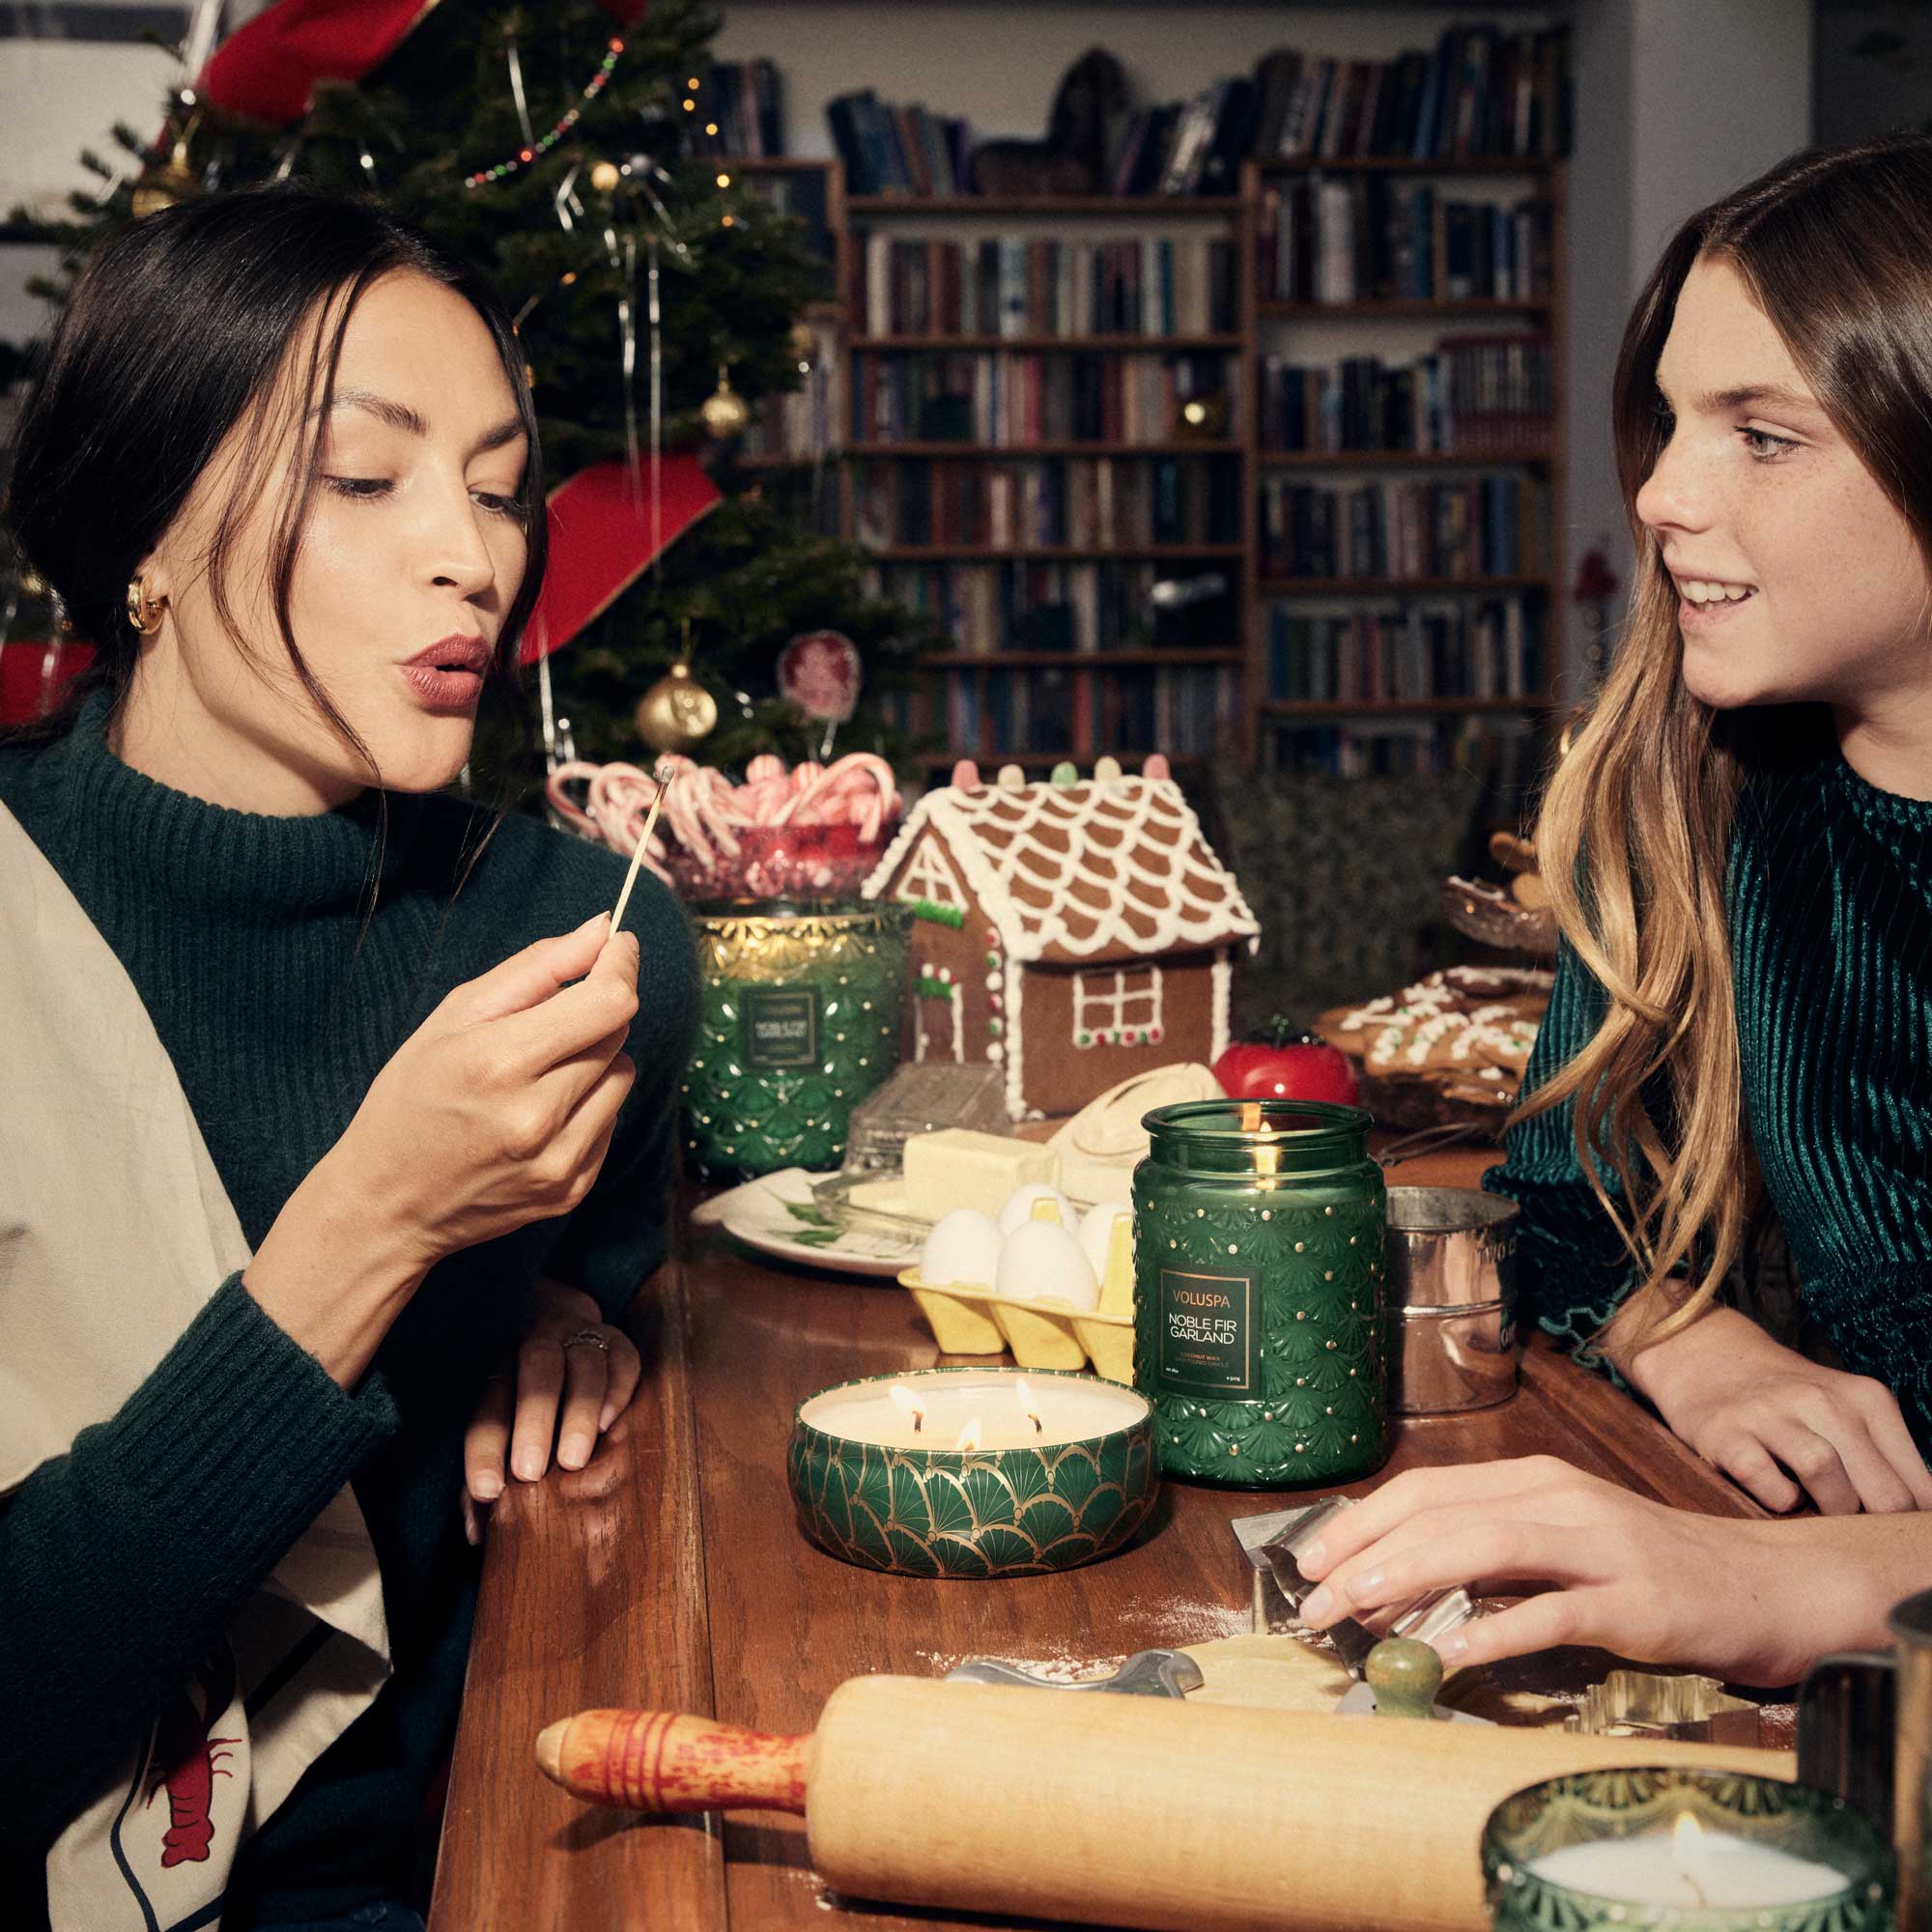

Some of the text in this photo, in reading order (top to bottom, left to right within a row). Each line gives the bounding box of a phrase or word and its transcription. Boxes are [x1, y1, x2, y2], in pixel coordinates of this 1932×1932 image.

[1174, 1290, 1231, 1308] VOLUSPA
[1169, 1313, 1236, 1332] NOBLE FIR
[1171, 1326, 1235, 1345] GARLAND
